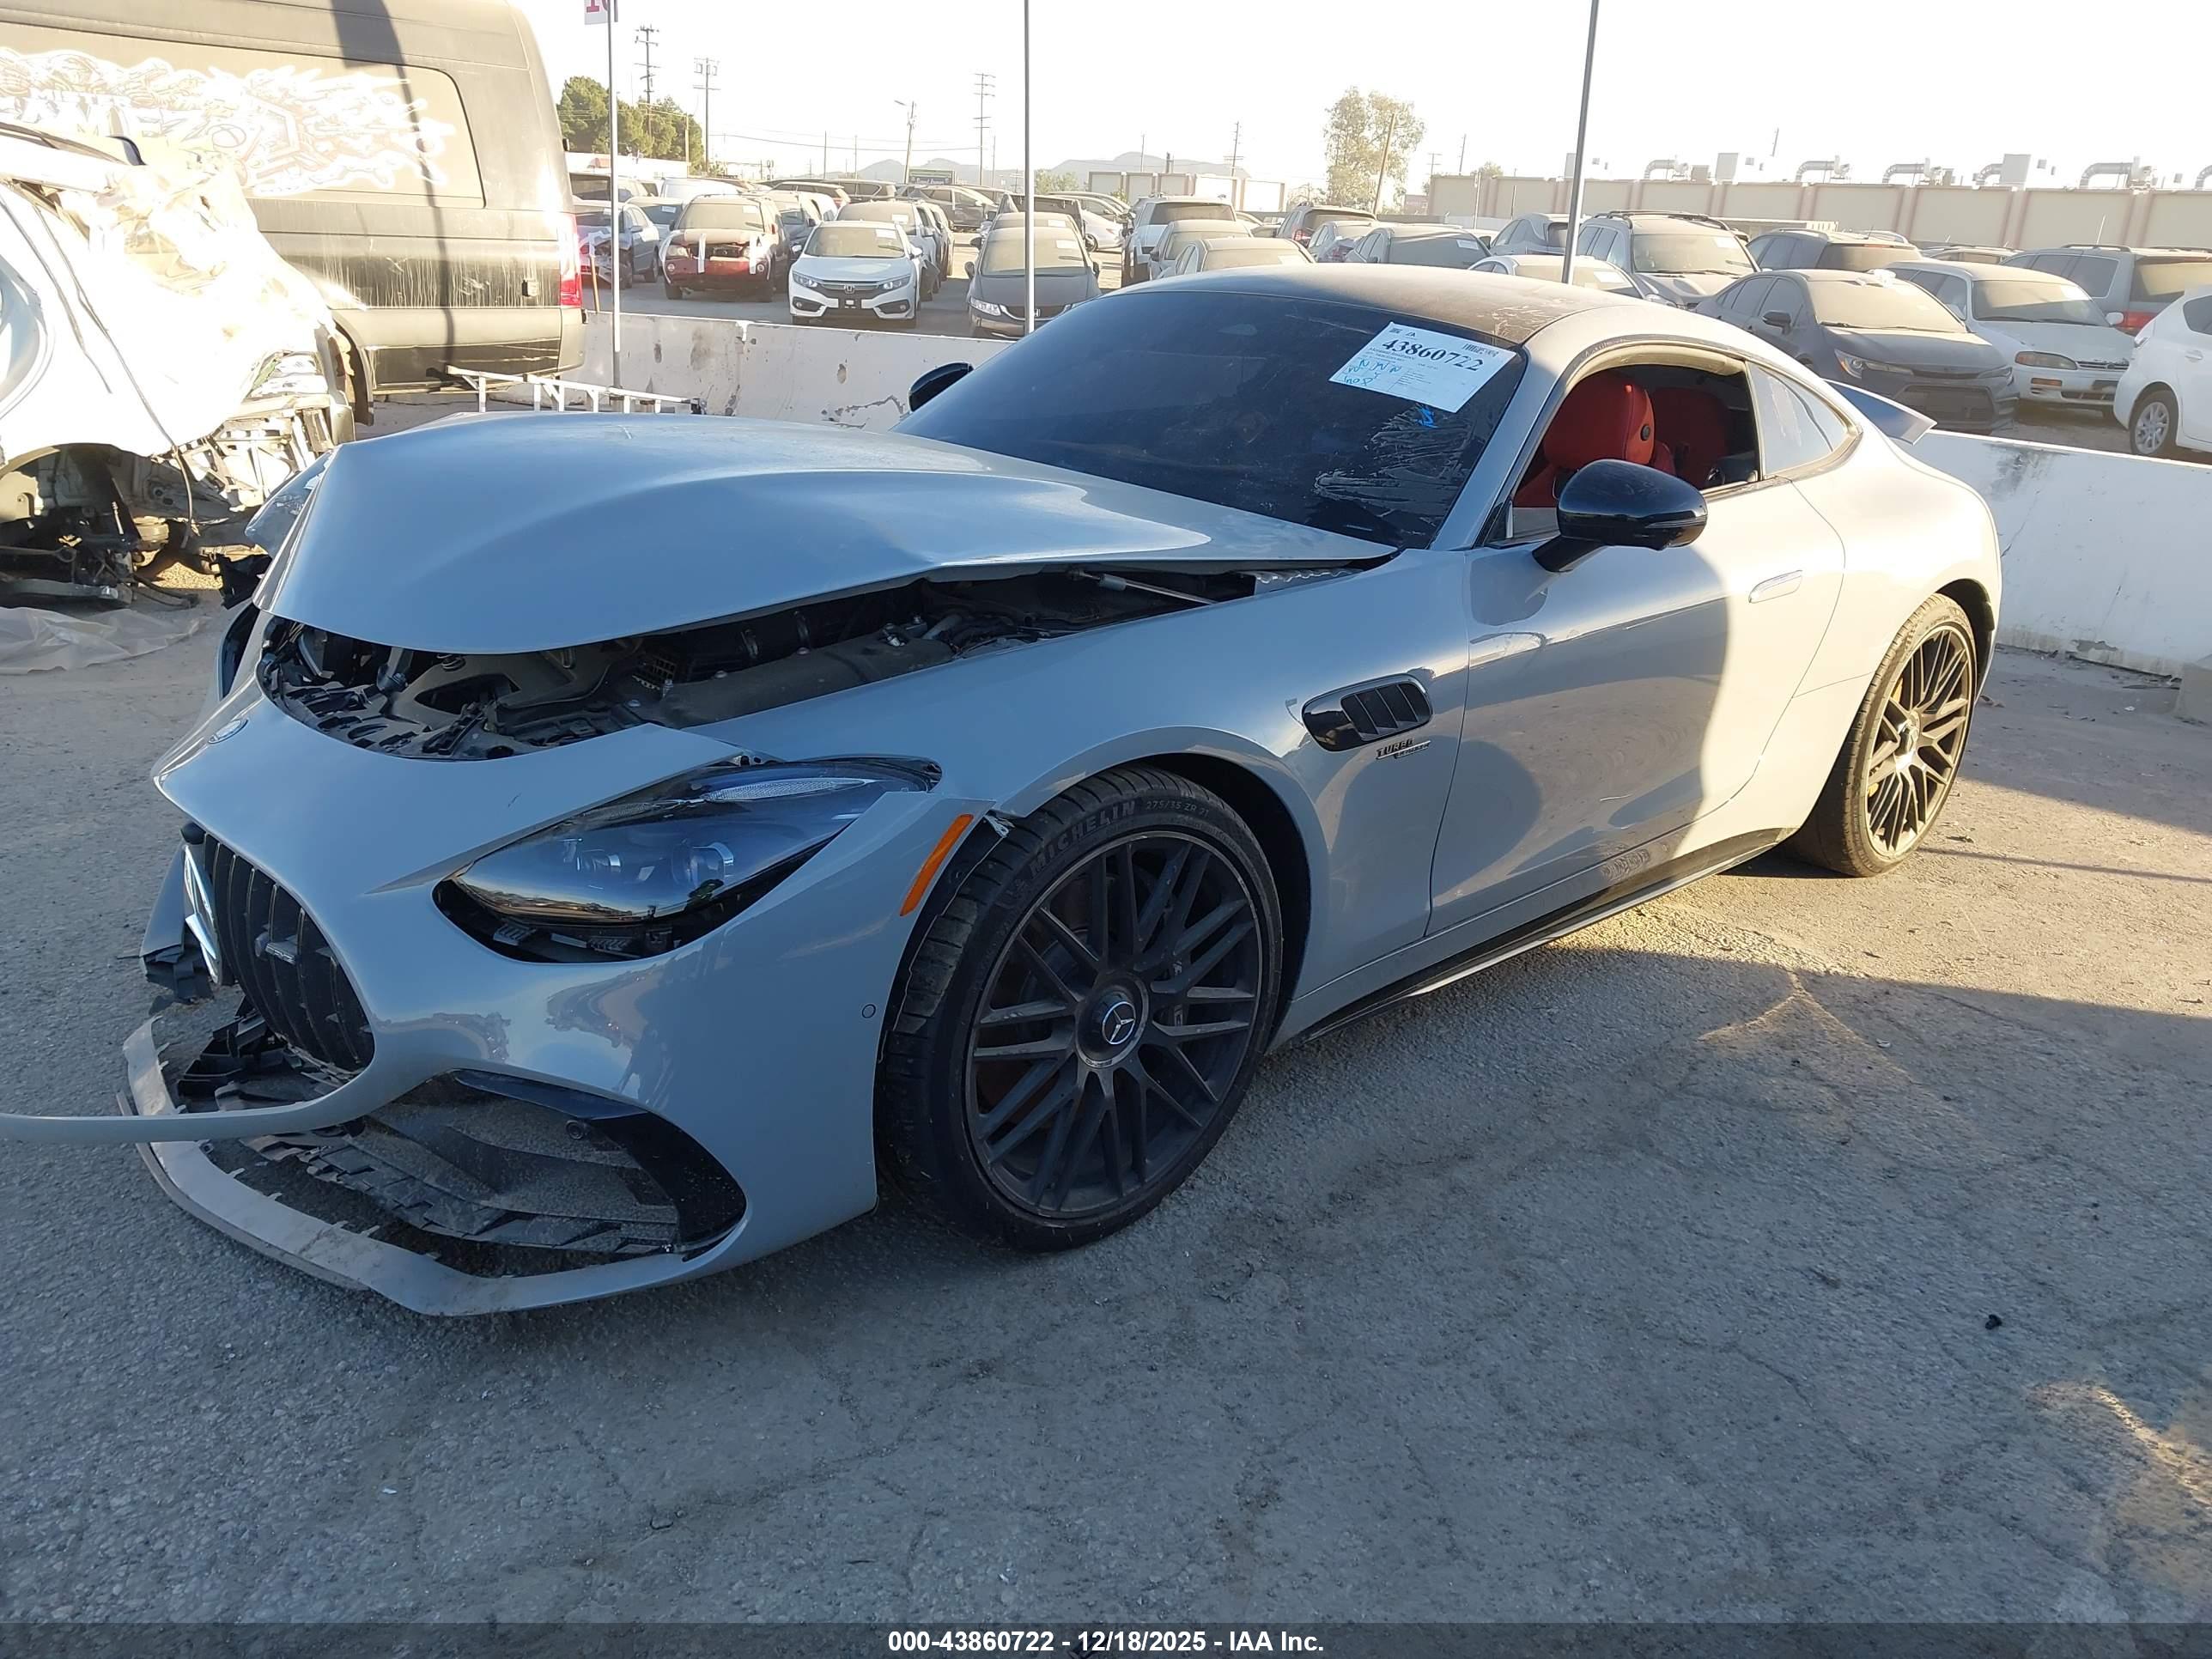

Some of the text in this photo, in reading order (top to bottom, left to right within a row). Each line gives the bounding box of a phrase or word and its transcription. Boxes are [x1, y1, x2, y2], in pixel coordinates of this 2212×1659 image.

[1382, 338, 1484, 372] 43860722
[1376, 738, 1414, 757] TURBO
[1029, 800, 1135, 876] MICHELIN
